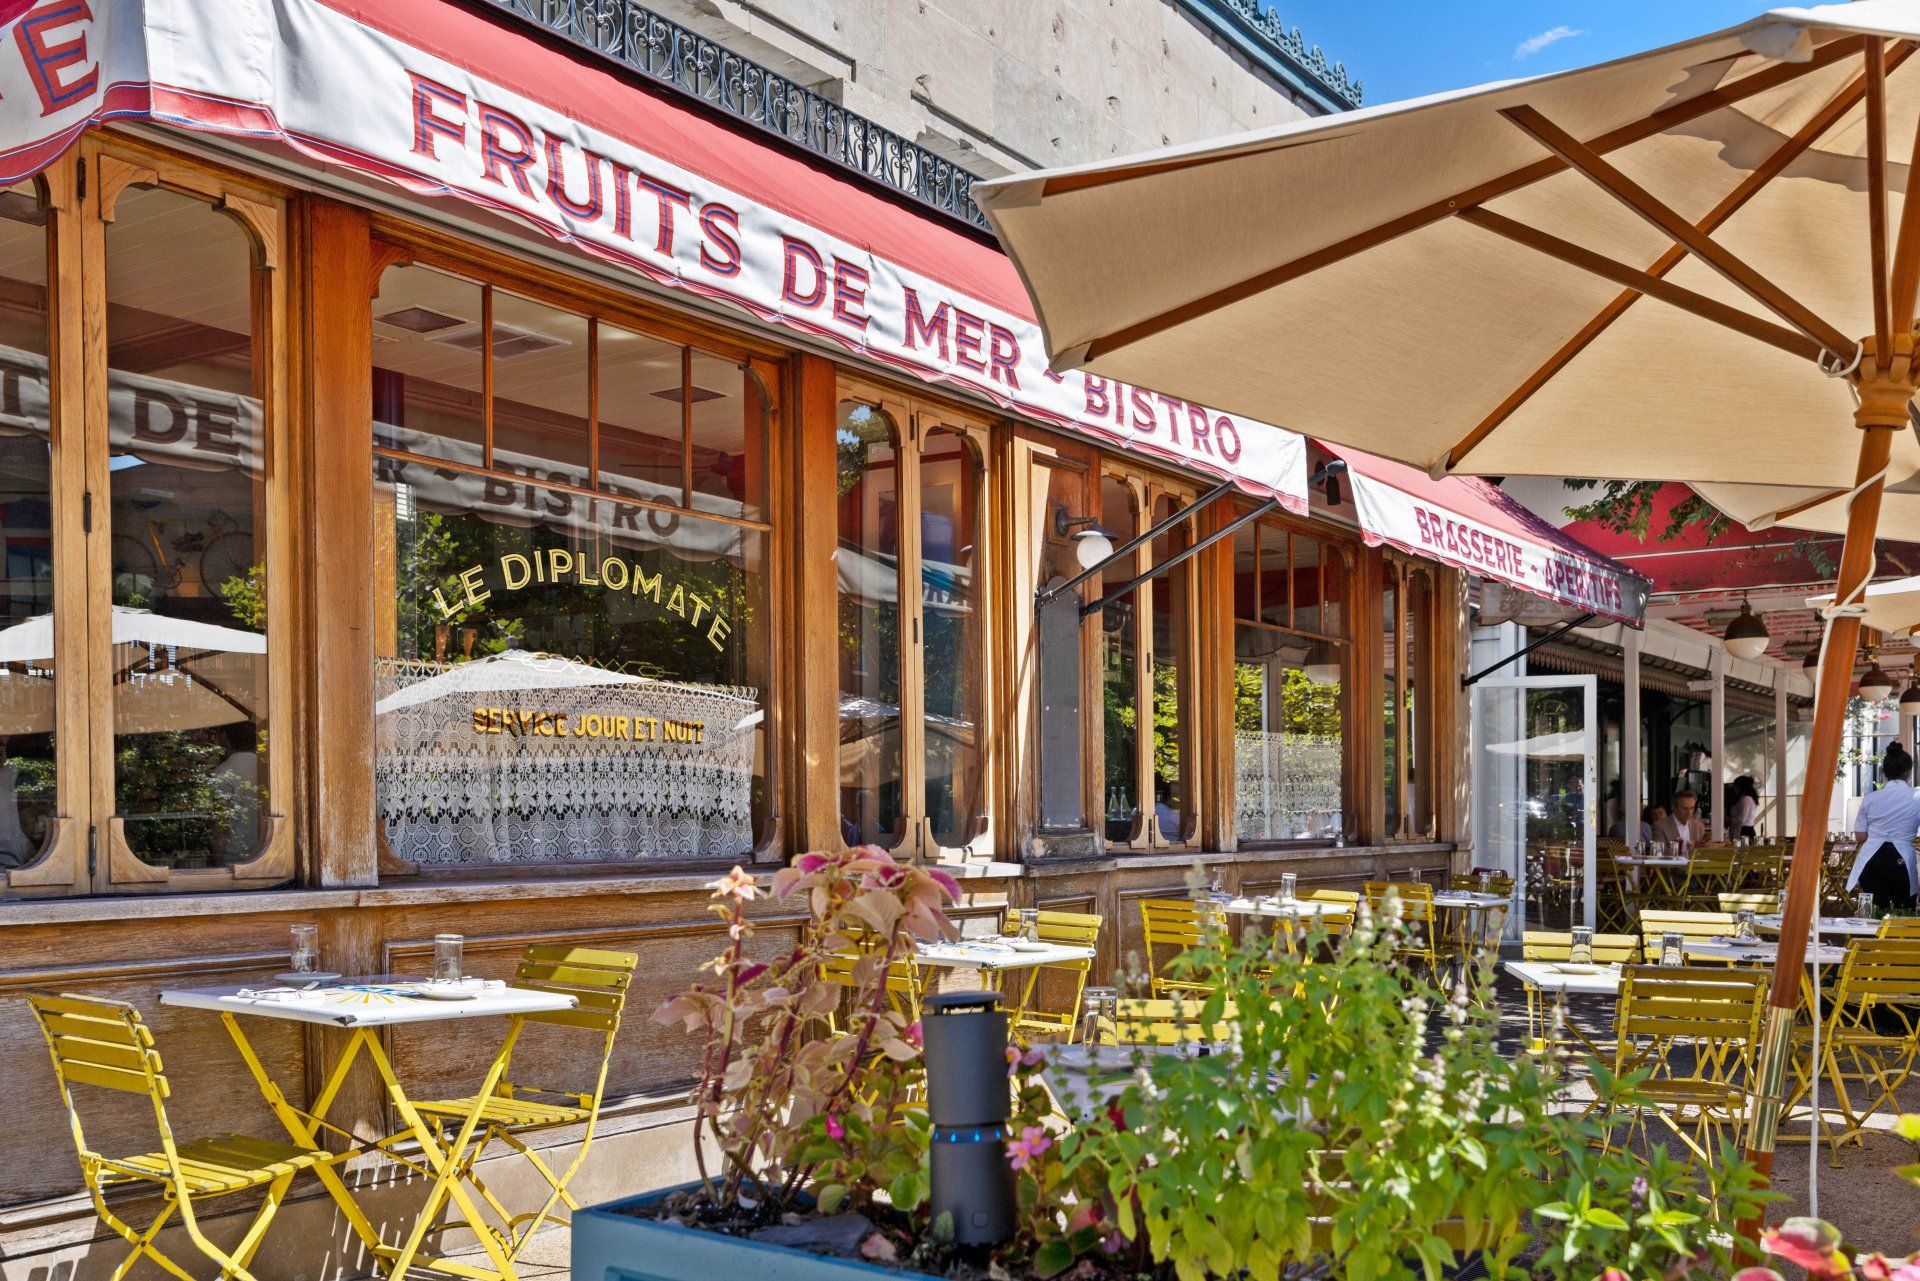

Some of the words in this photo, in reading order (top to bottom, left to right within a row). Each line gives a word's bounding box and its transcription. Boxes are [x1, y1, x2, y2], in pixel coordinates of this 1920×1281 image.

[404, 68, 741, 279] FRUITS
[780, 234, 871, 331] DE
[902, 286, 1022, 391] MER
[1084, 372, 1241, 465] BISTRO
[132, 387, 240, 455] DE
[484, 459, 680, 537] BISTRO
[432, 564, 491, 619] LE
[500, 549, 731, 652] DIPLOMATE
[1414, 506, 1525, 578] BRASSERIE
[1545, 557, 1622, 609] APERITIFS
[473, 707, 568, 736] SERVICE
[574, 714, 629, 740] JOUR
[633, 717, 658, 741] ET
[664, 720, 704, 743] NUIT
